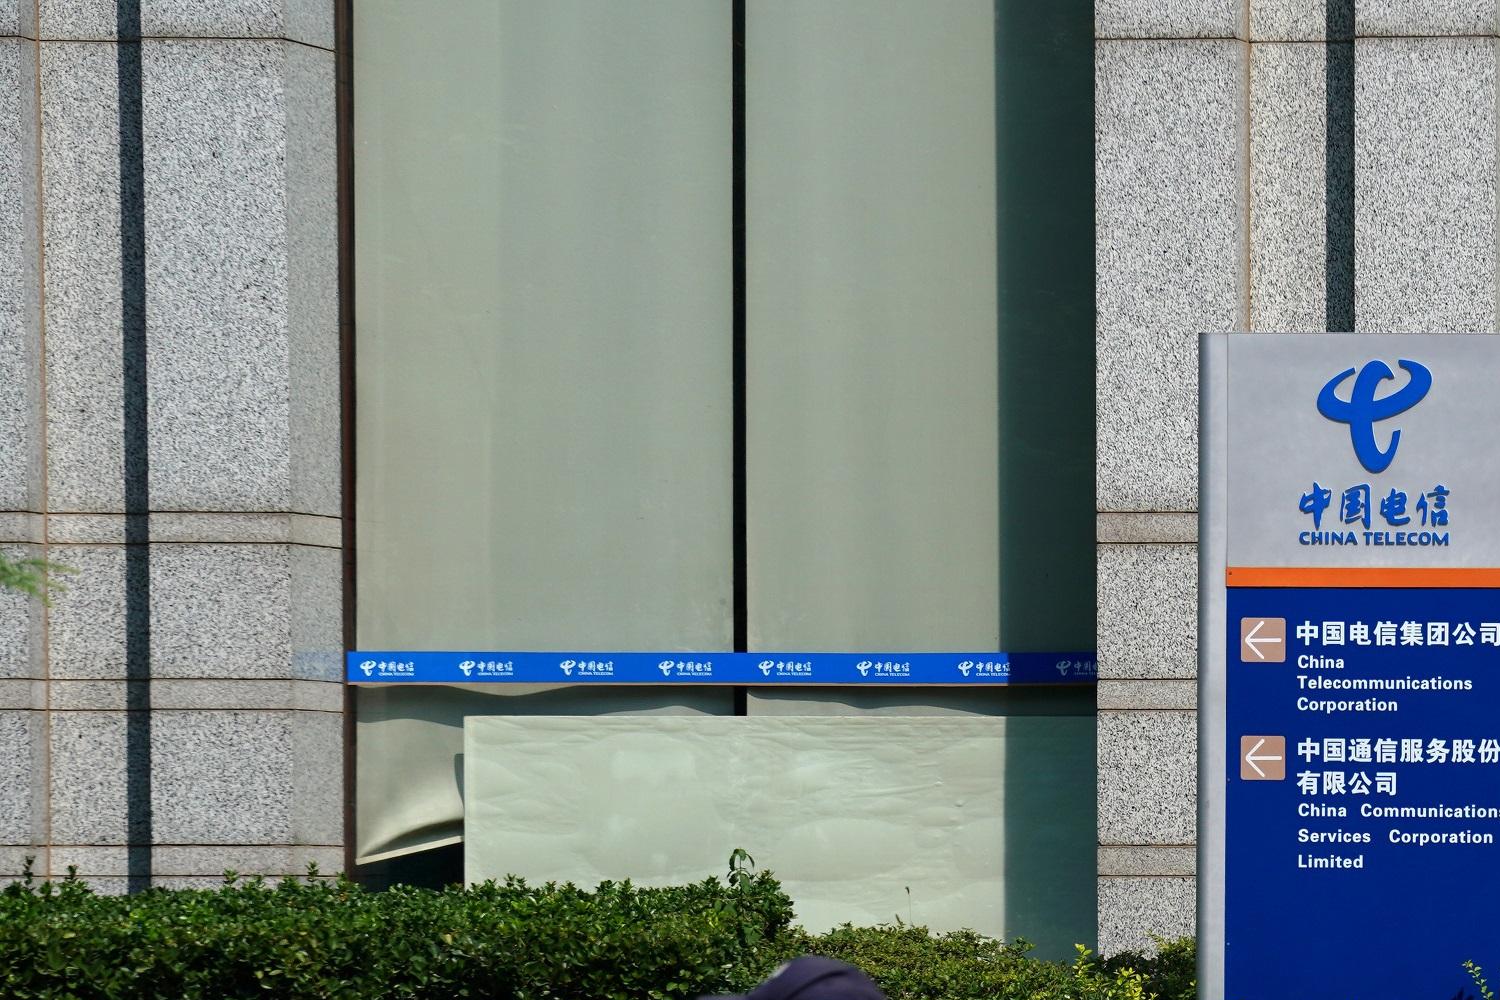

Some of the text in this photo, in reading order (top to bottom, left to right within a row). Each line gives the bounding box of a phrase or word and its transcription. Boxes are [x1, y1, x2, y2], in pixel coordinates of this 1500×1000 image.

[1299, 482, 1450, 530] 中国电信
[1299, 531, 1449, 546] CHINA TELECOM
[1297, 655, 1345, 669] China
[1297, 676, 1473, 690] Telecommunications
[1297, 697, 1398, 714] Corporation
[1297, 738, 1500, 763] 中国通信服务股份
[1296, 771, 1397, 796] 有限公司
[1298, 803, 1347, 817] China
[1298, 829, 1493, 846] Services Corporation
[1298, 855, 1364, 869] Limited
